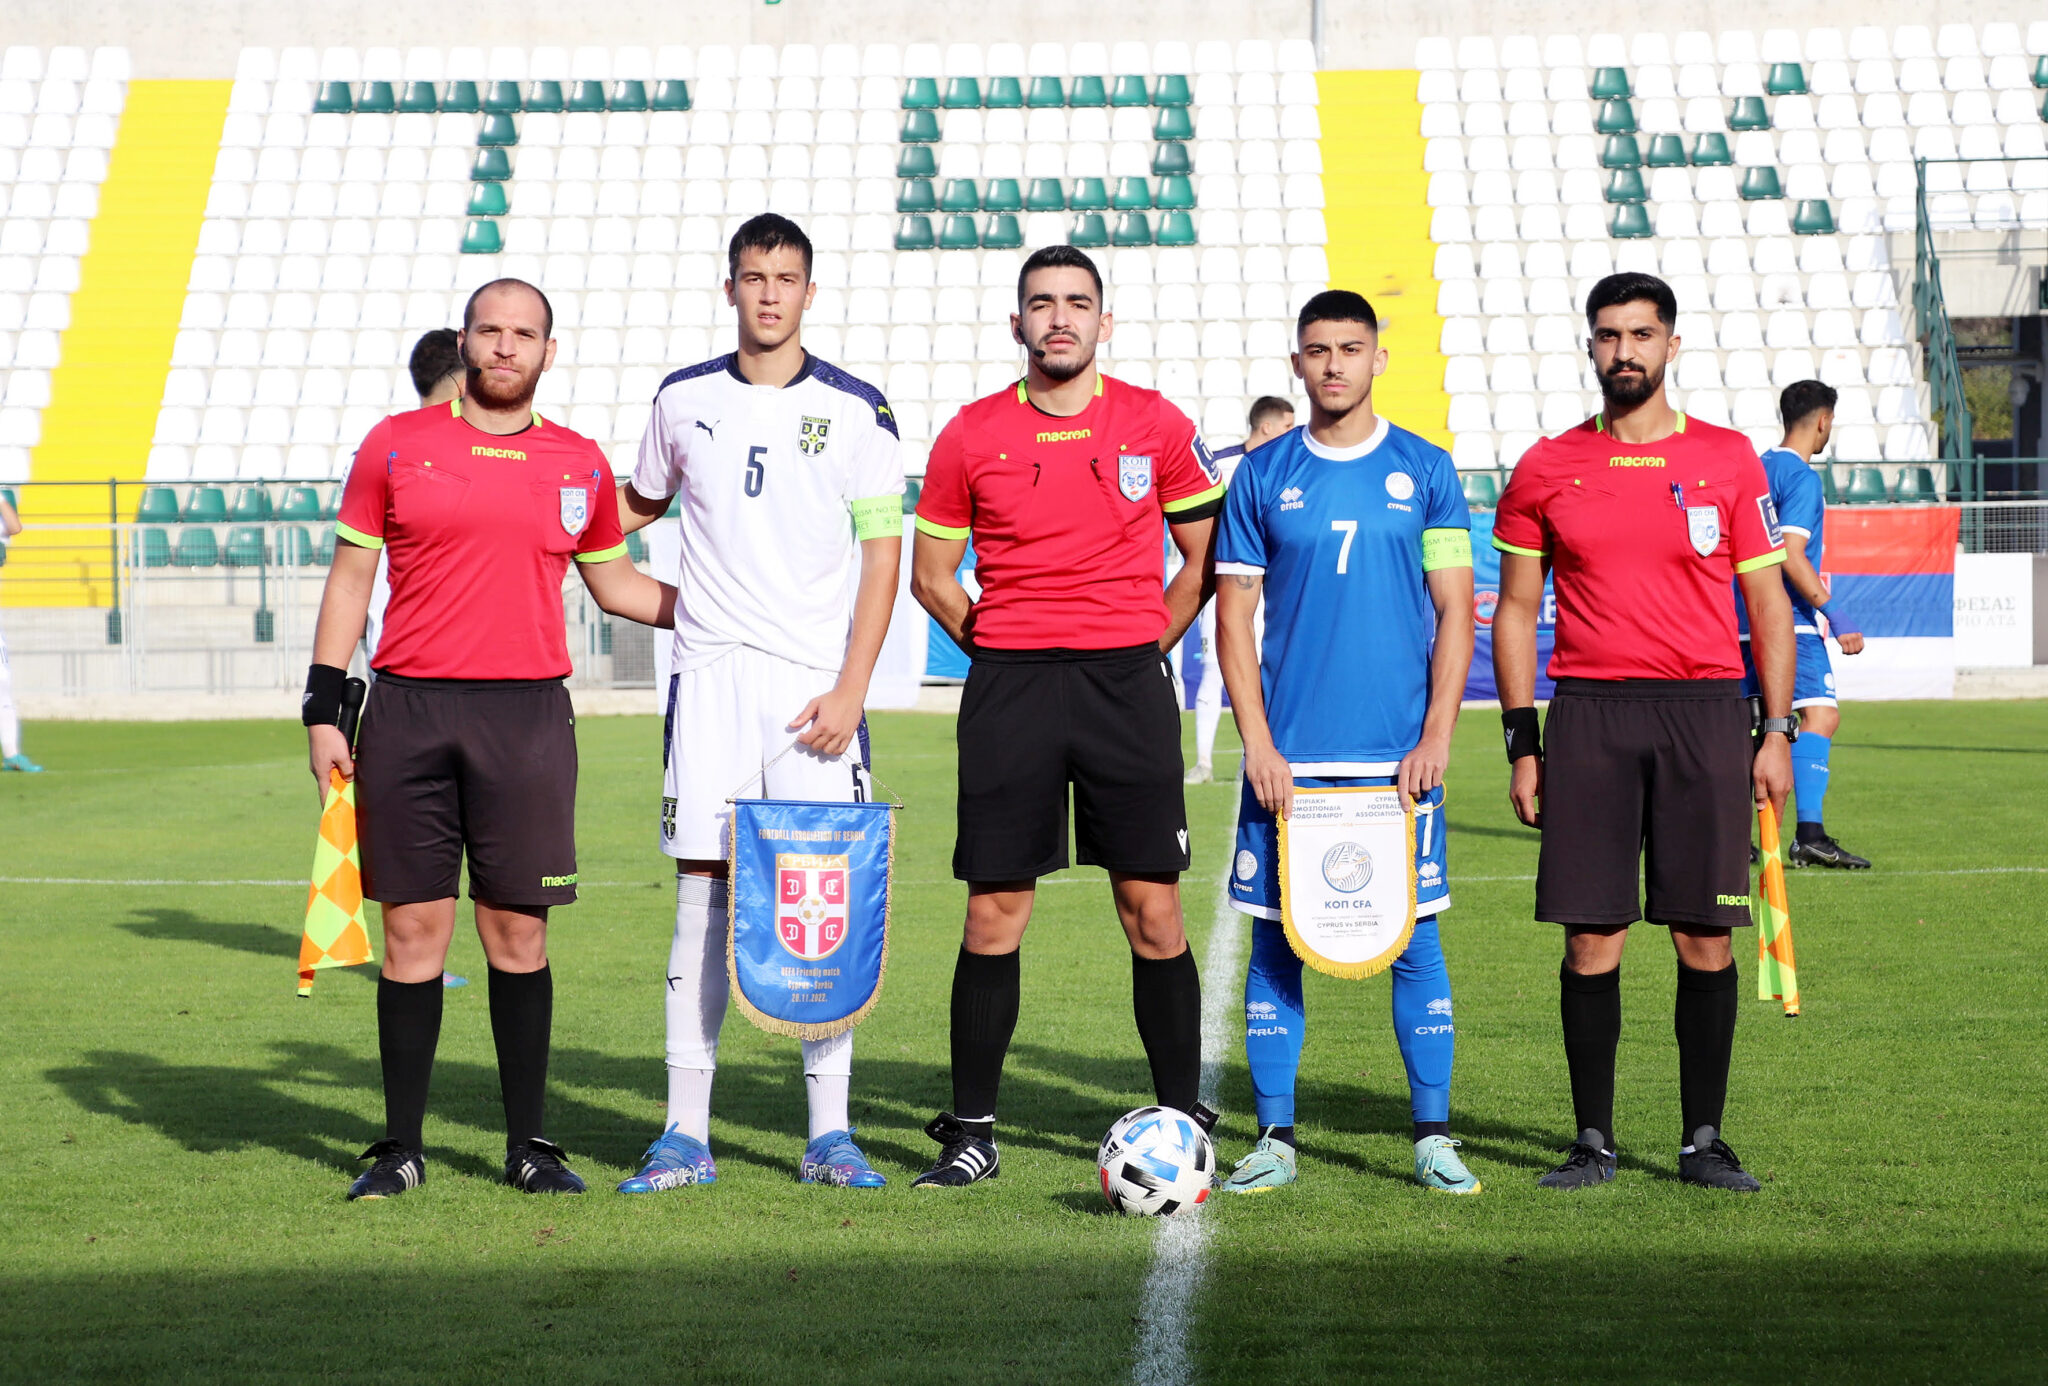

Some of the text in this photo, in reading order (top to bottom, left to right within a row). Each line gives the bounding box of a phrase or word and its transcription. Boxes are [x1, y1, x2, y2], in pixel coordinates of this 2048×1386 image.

[1036, 428, 1092, 443] macron
[471, 446, 528, 461] macron
[1609, 456, 1666, 467] macron
[744, 445, 768, 497] 5
[1331, 520, 1358, 575] 7
[852, 763, 865, 802] 5
[1352, 900, 1372, 908] CFA
